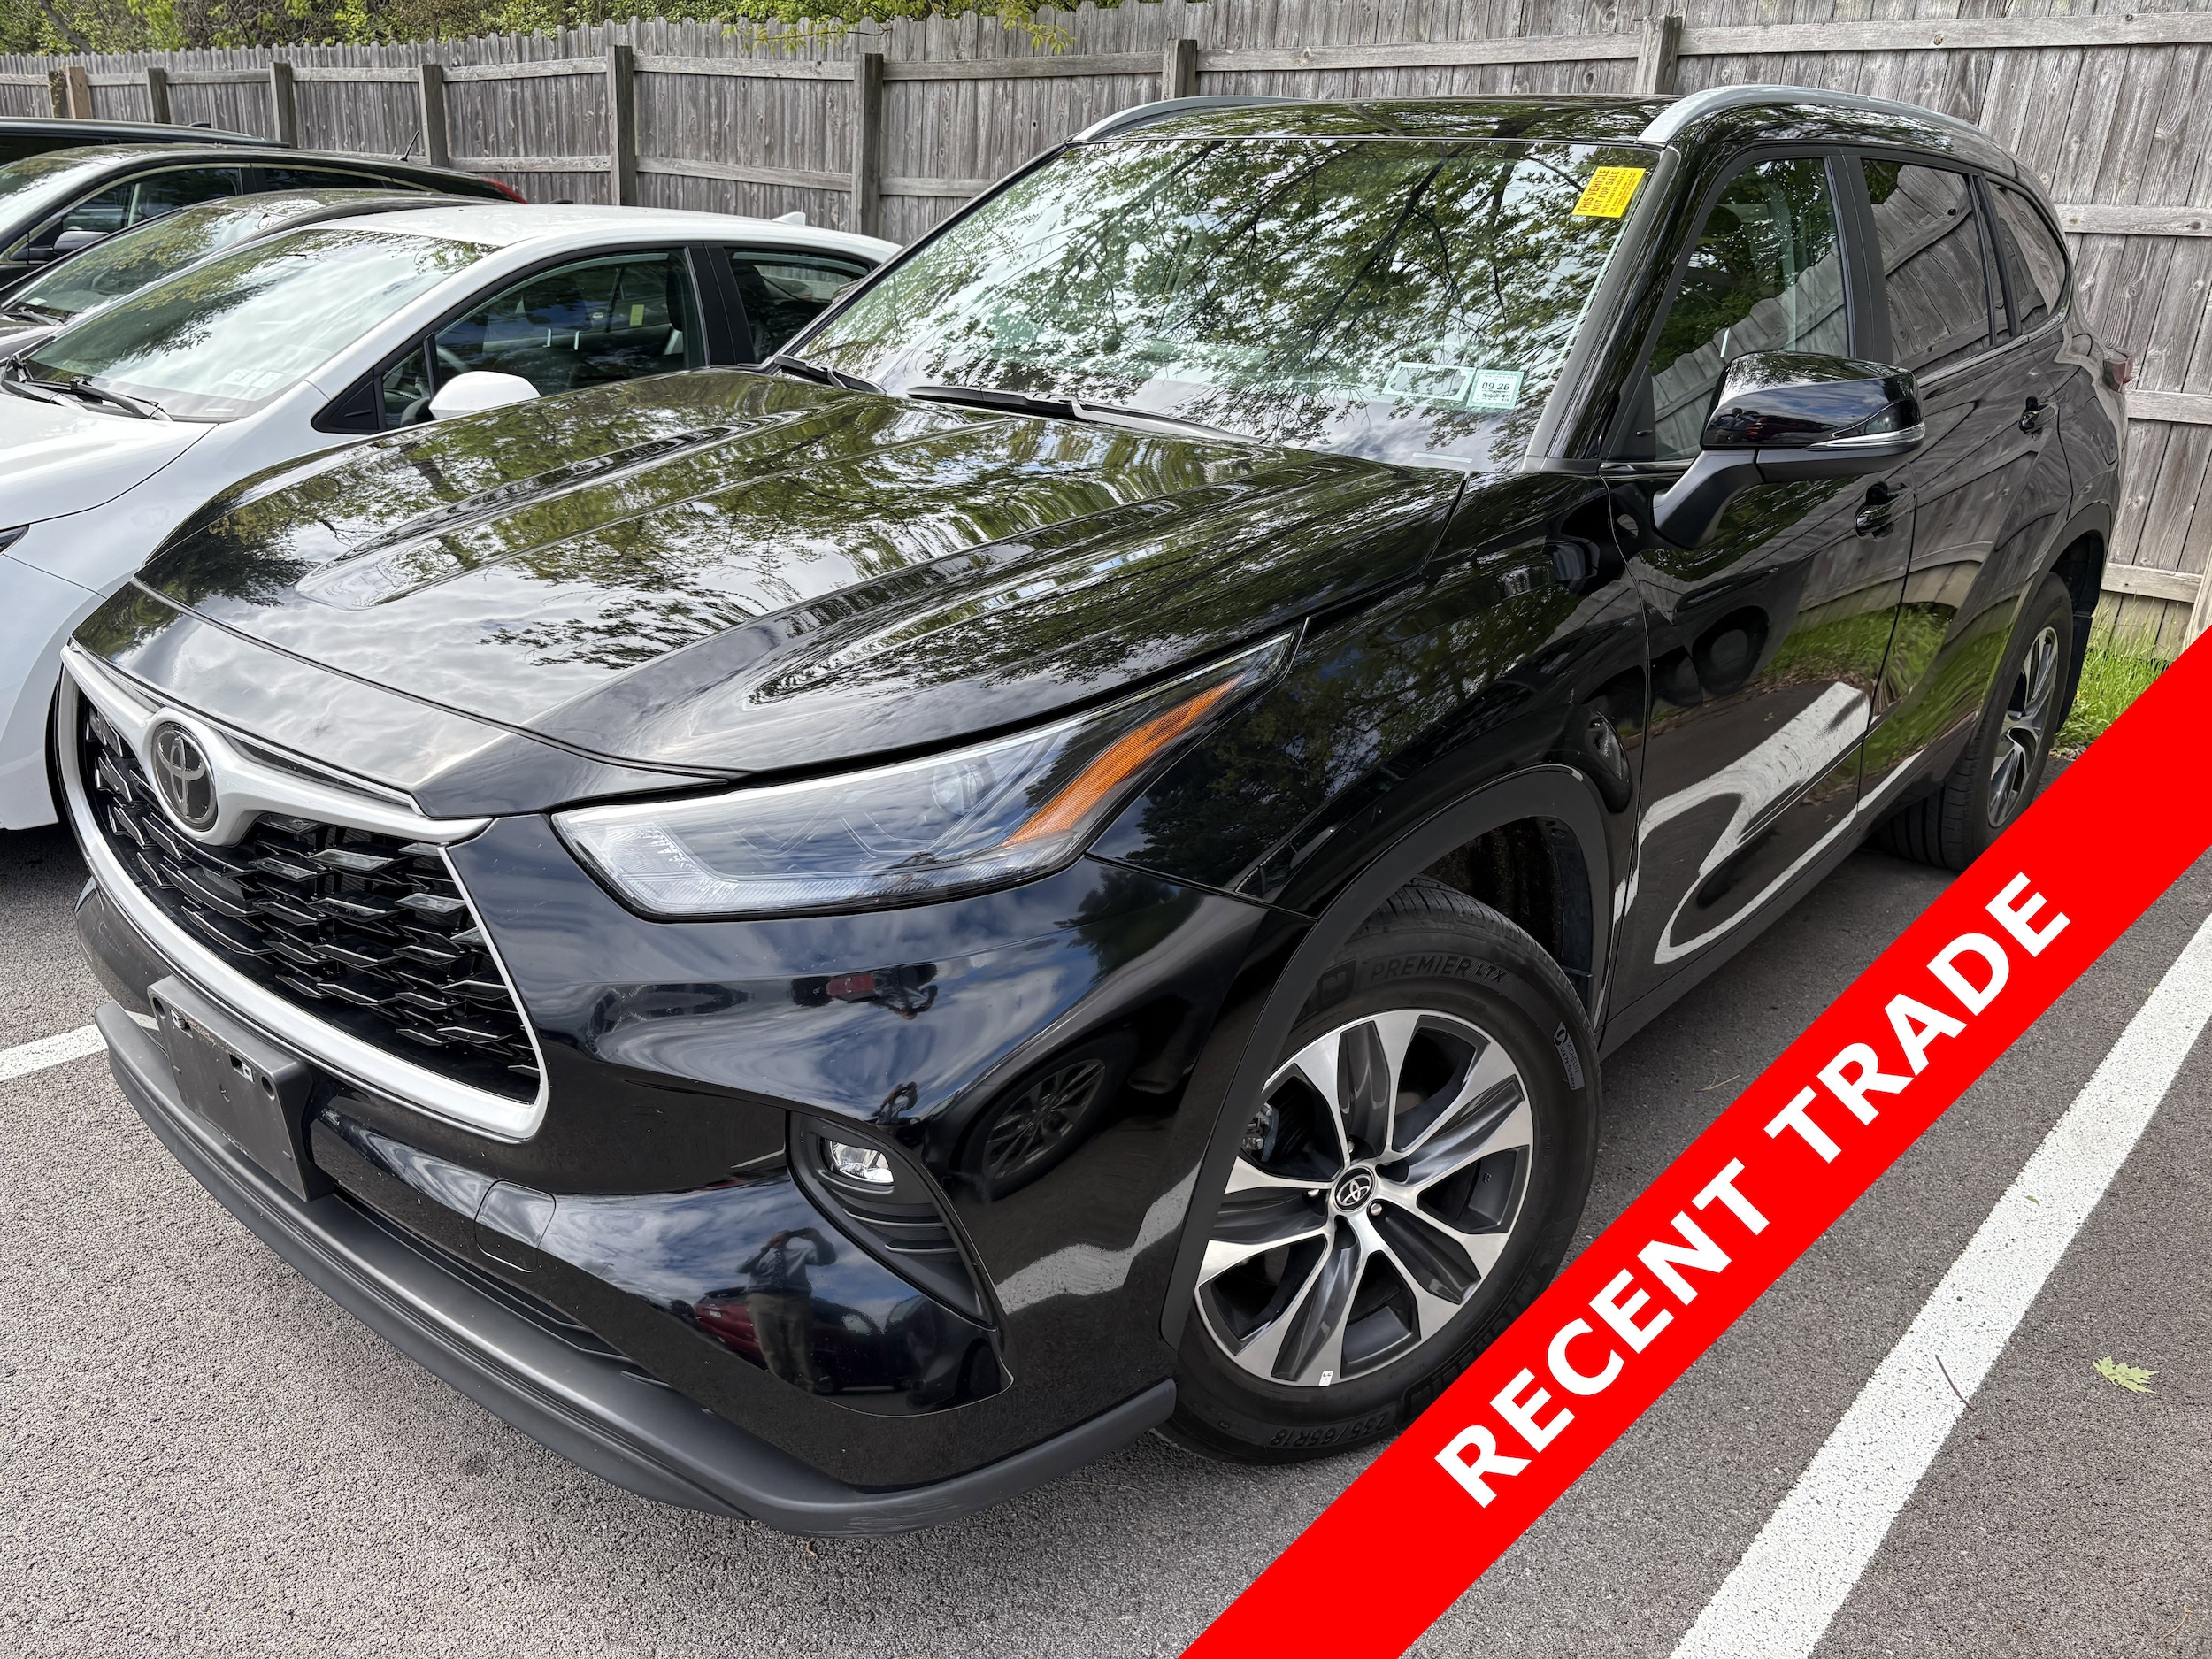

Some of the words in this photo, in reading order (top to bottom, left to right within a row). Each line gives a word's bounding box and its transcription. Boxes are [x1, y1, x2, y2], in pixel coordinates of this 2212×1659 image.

[1577, 196, 1594, 212] THIS
[1587, 169, 1610, 196] VEHICLE
[1590, 199, 1603, 211] NOT
[1598, 187, 1610, 198] FOR
[1605, 170, 1620, 185] SALE
[1371, 955, 1472, 982] PREMIER
[1474, 962, 1506, 983] LTX
[1565, 1041, 1580, 1073] MICHELIN
[1270, 1411, 1388, 1447] 235/65R18
